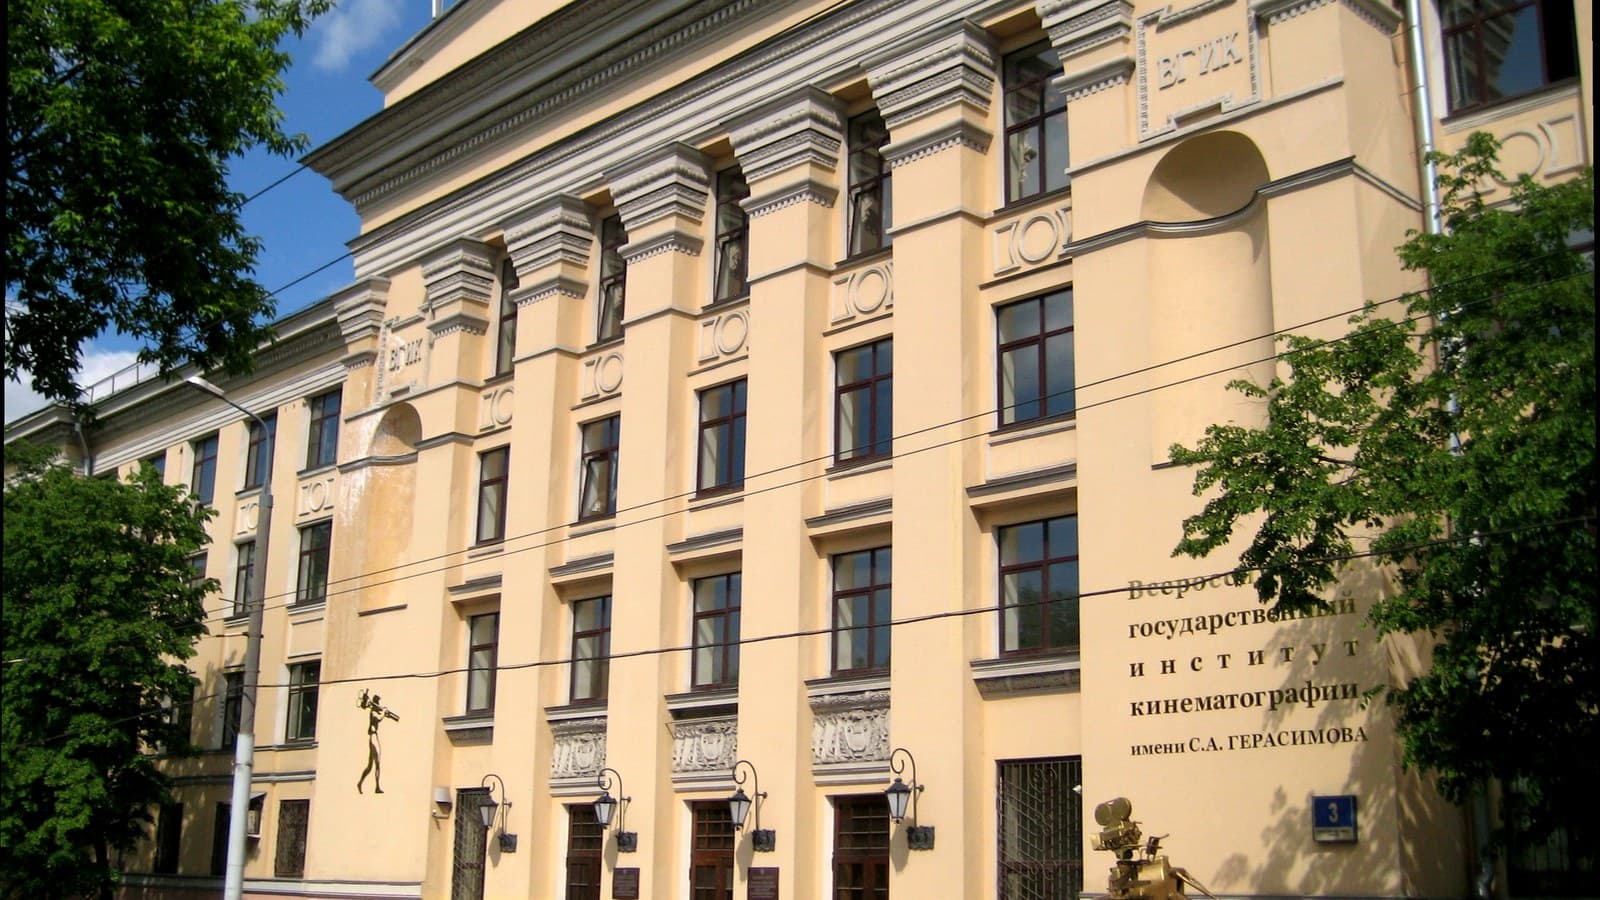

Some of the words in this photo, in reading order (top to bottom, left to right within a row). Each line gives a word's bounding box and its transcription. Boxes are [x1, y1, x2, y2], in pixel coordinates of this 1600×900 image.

[1157, 31, 1242, 91] ВГИК
[1129, 639, 1359, 677] институт
[1130, 680, 1359, 716] кинематографии
[1130, 742, 1185, 756] имени
[1188, 737, 1223, 753] С.А.
[1228, 726, 1369, 750] ГЕРАСИМОВА
[1328, 803, 1339, 823] 3
